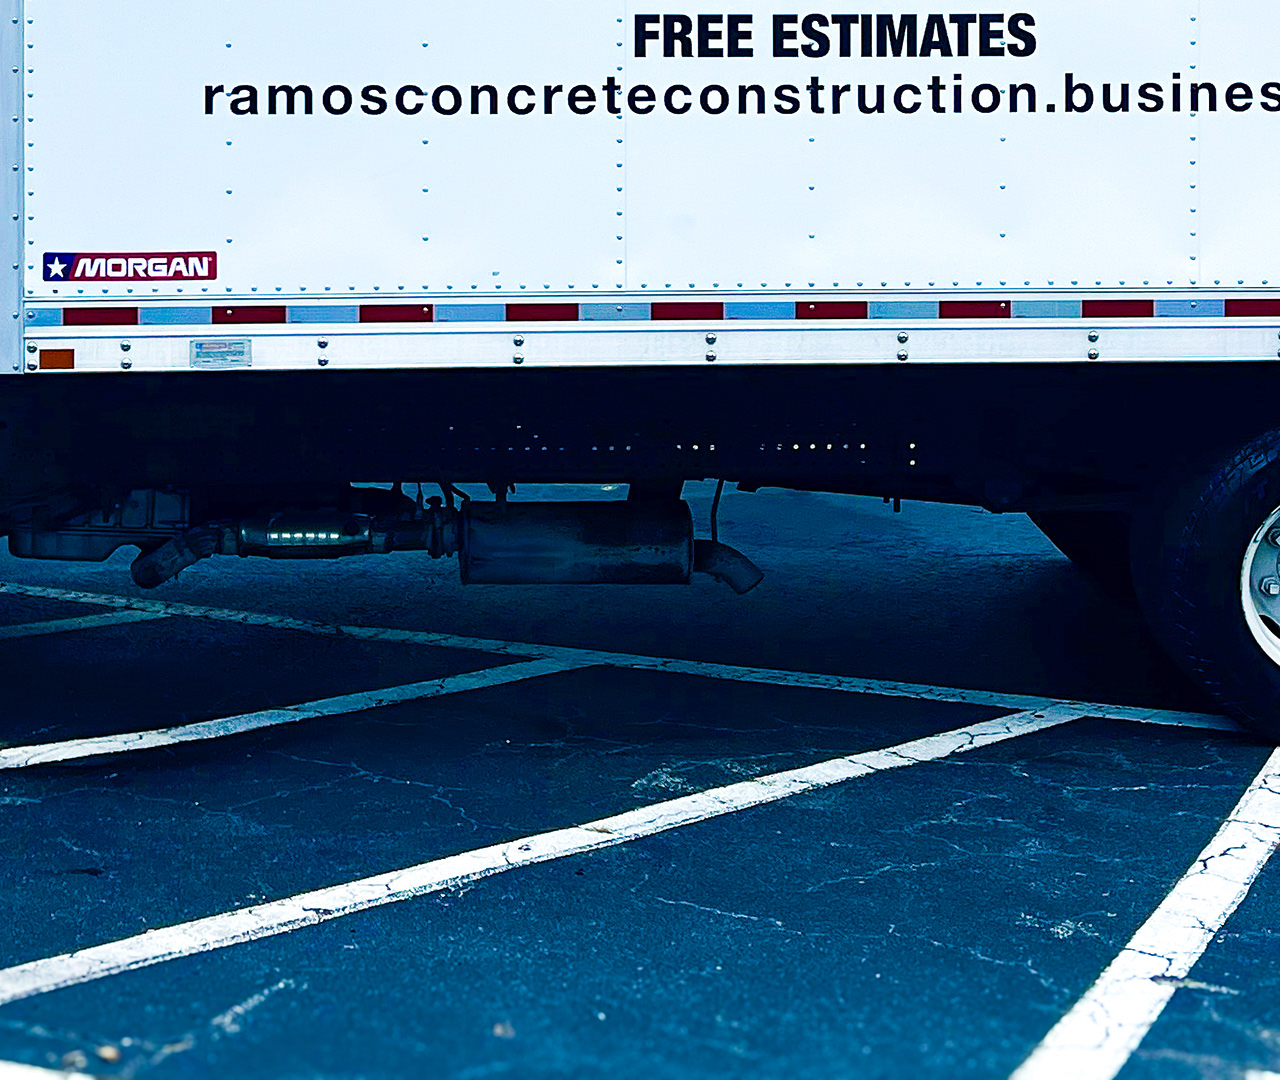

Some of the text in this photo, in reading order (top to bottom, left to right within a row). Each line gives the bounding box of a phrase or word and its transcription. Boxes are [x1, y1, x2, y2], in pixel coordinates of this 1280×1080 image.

[634, 12, 1037, 58] FREE ESTIMATES
[74, 256, 209, 278] MORGAN
